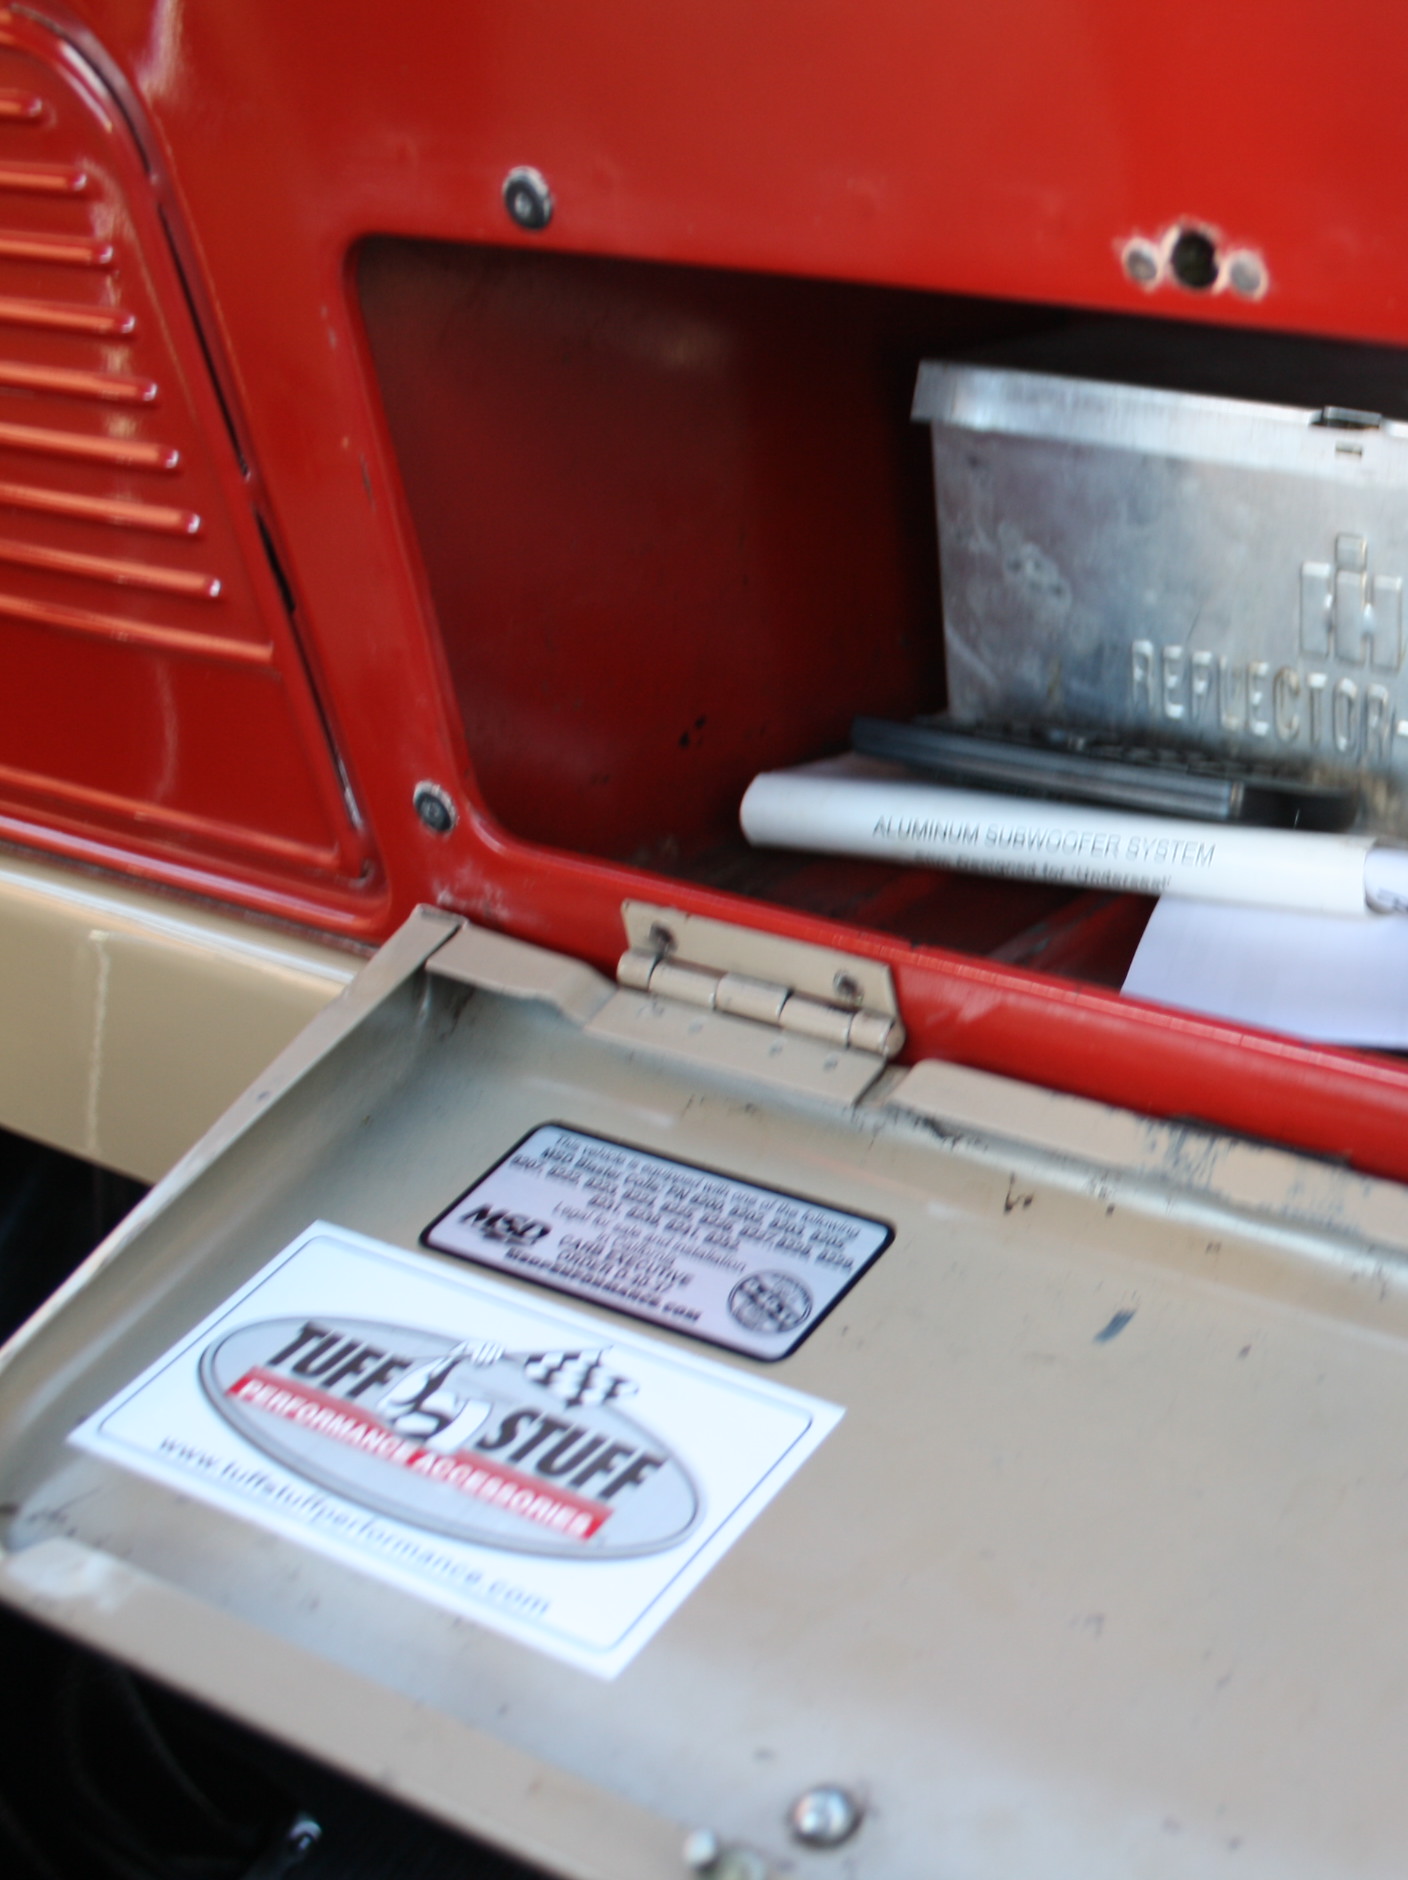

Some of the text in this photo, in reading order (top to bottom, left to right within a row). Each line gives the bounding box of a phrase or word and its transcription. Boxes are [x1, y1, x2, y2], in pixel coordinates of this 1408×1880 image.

[872, 815, 1216, 869] ALUMINUM SUBWOOFER SYSTEM
[540, 1147, 576, 1164] MSD
[268, 1320, 411, 1399] TUFF
[237, 1379, 595, 1538] PERFORMANCE ACCESSORIES
[476, 1406, 669, 1500] STUFF
[159, 1436, 551, 1616] www.tuffstuffperformance.com
